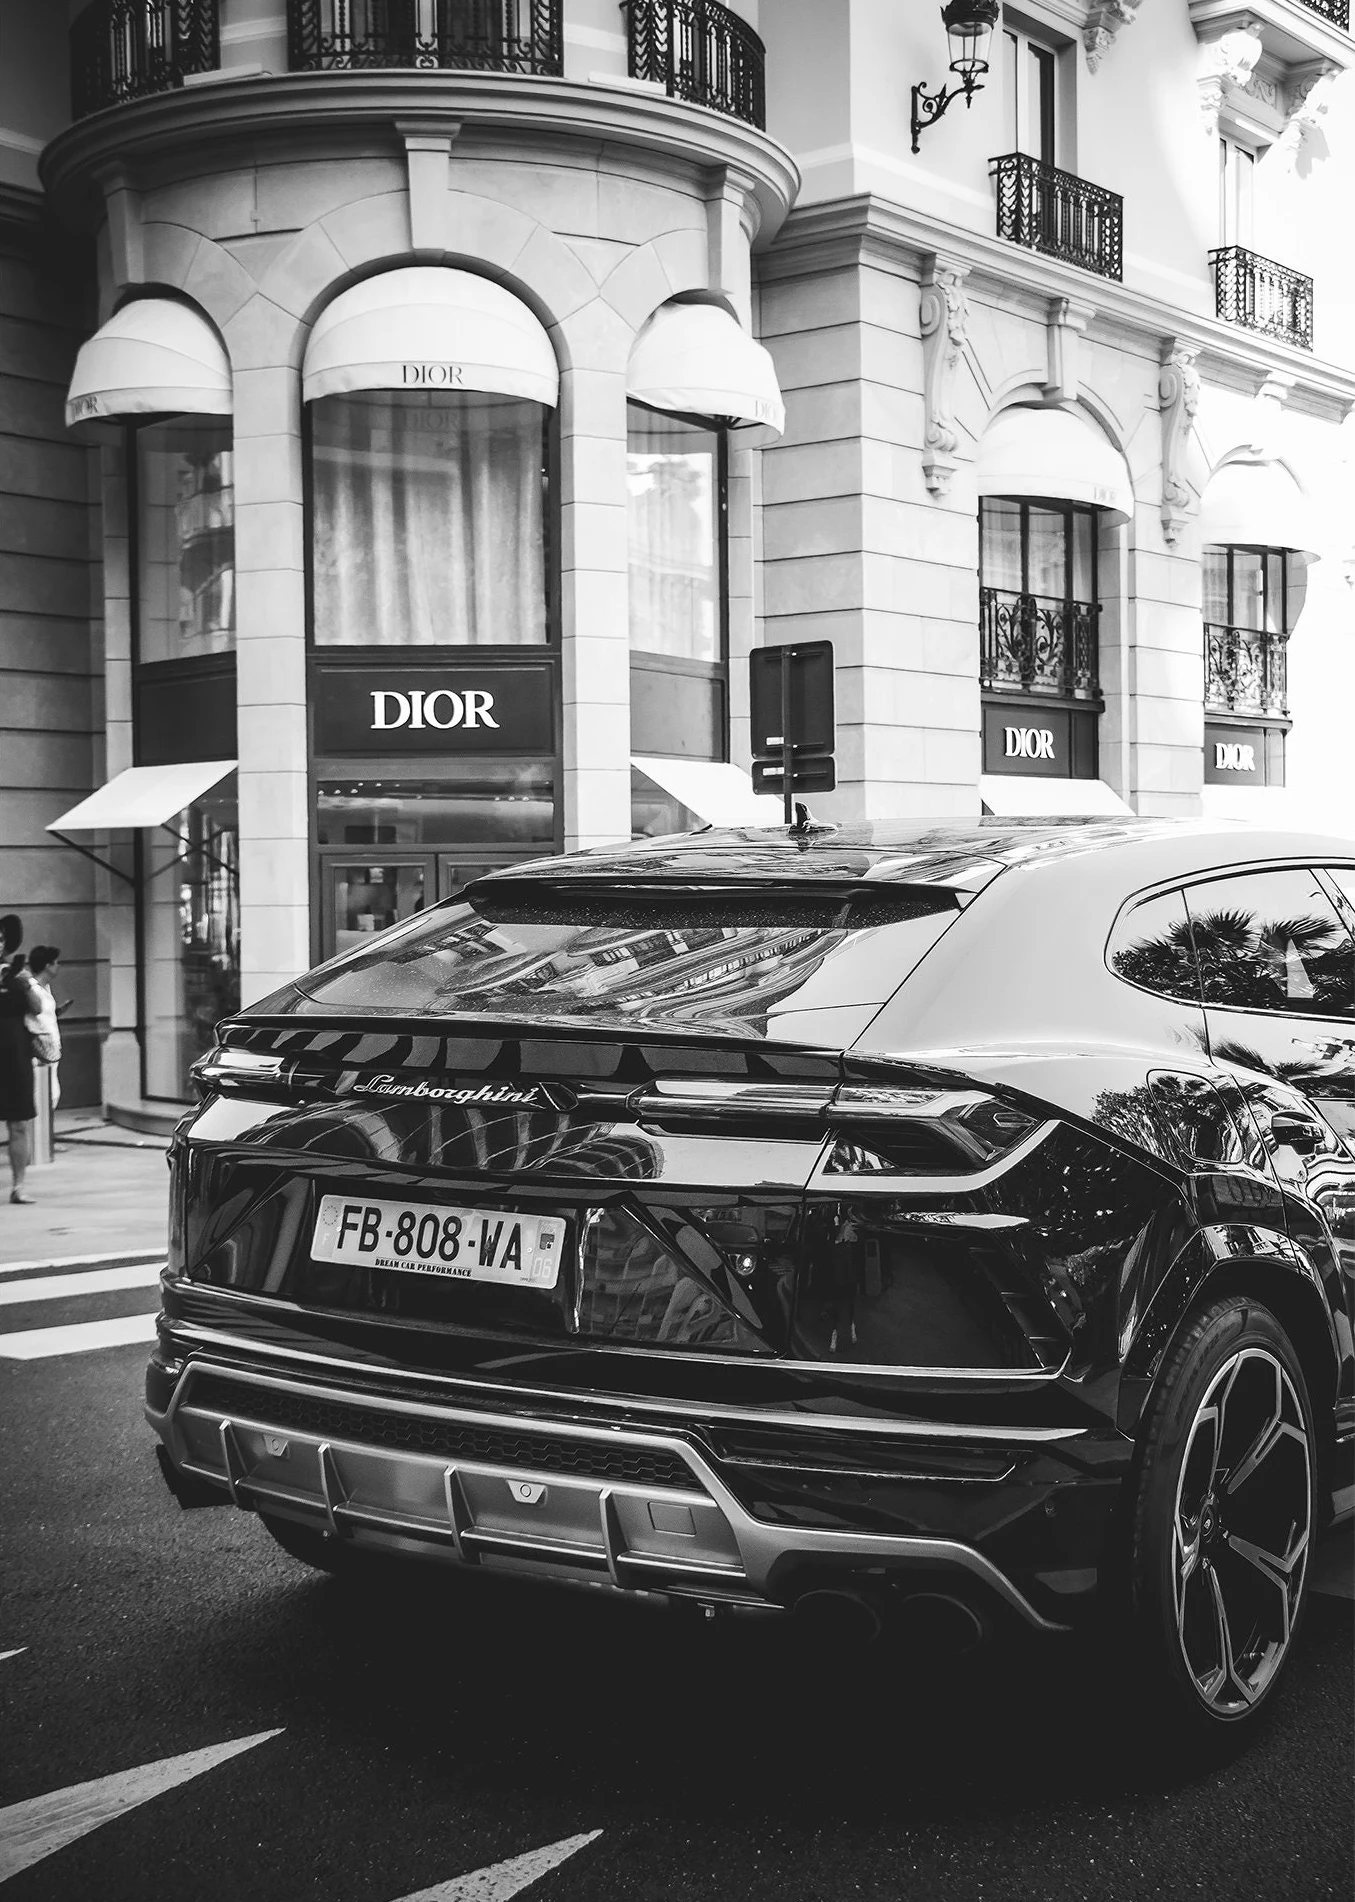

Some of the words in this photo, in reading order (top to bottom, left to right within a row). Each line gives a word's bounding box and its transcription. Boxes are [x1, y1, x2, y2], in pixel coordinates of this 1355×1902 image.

[402, 364, 464, 385] DIOR
[369, 689, 501, 730] DIOR
[1004, 726, 1056, 759] DIOR
[1215, 742, 1256, 771] DIOR
[353, 1074, 539, 1104] Lamborghini
[375, 1258, 398, 1268] DREAM
[401, 1261, 415, 1270] CAR
[417, 1263, 472, 1277] PERFORMANCE
[532, 1257, 553, 1278] 06
